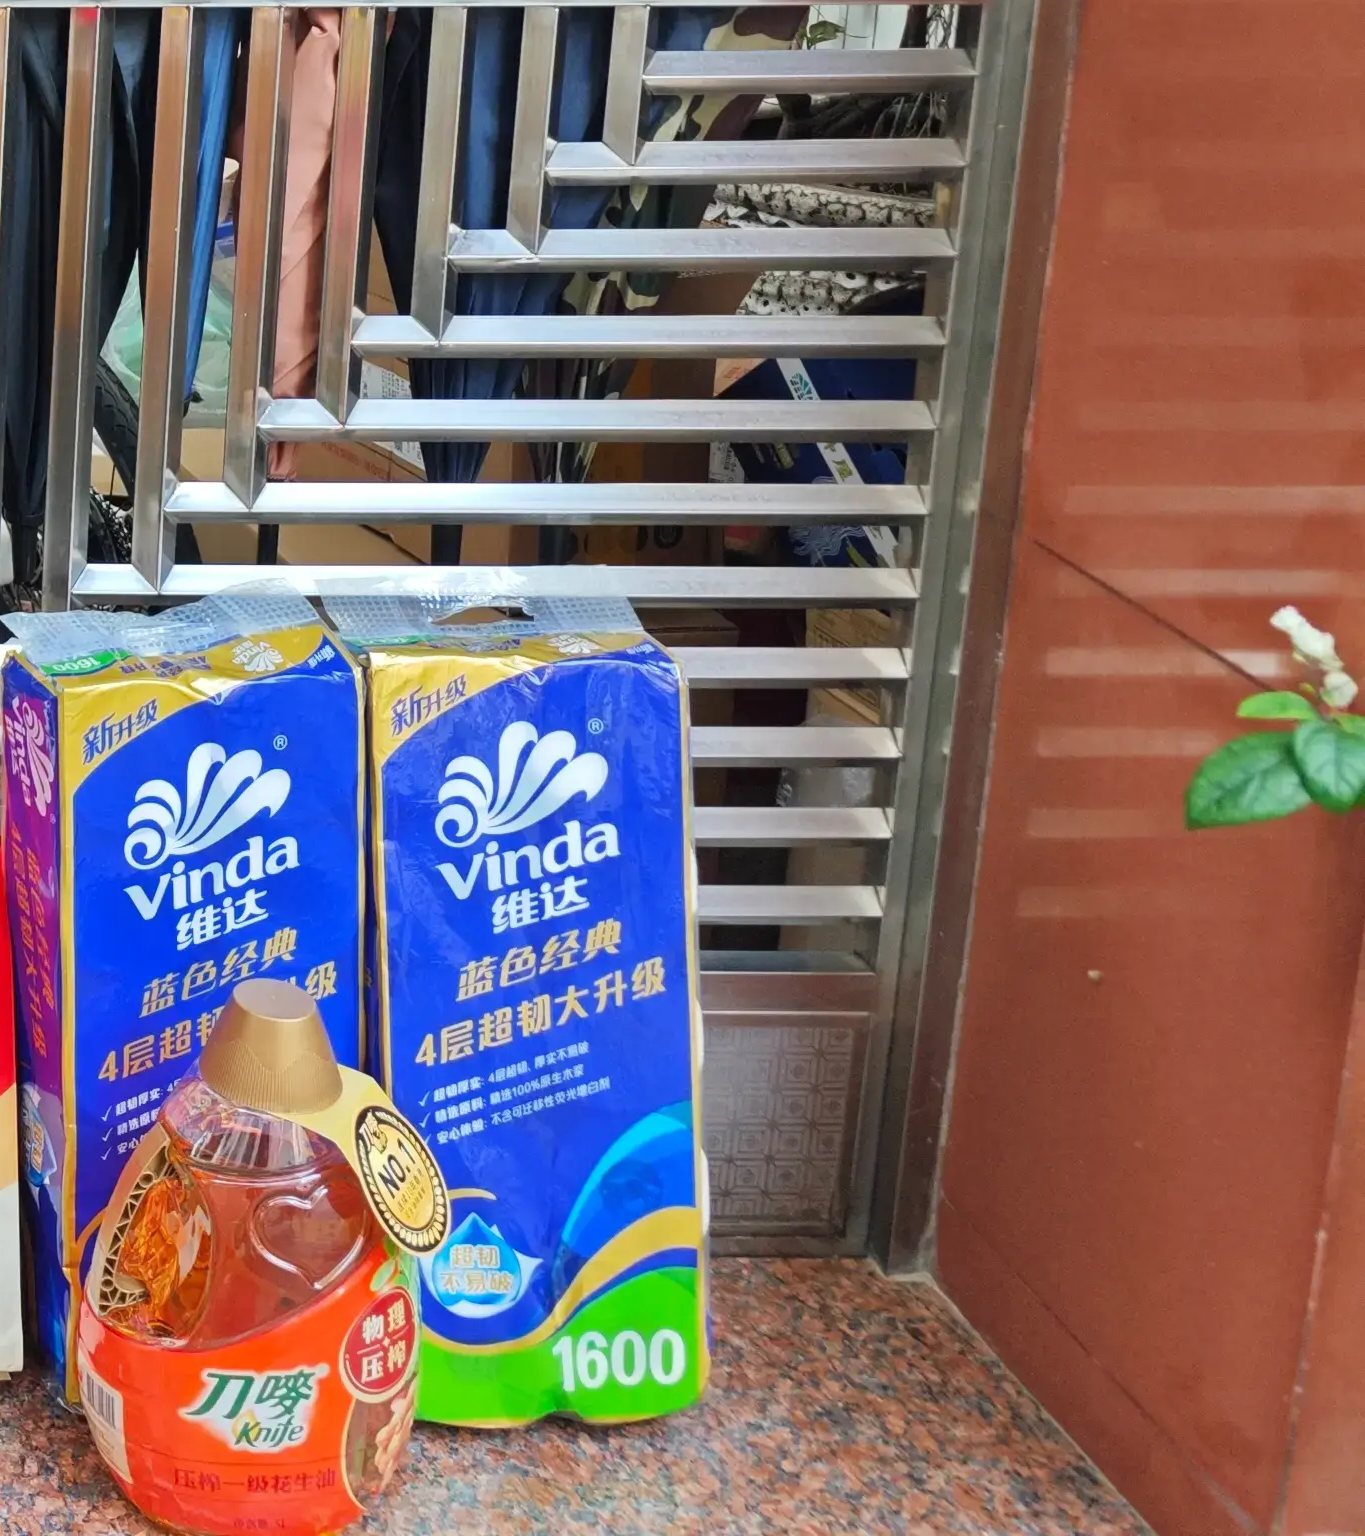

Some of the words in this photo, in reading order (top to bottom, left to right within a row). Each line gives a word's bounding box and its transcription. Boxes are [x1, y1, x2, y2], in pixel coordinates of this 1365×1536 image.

[81, 698, 158, 766] 新升级
[390, 674, 467, 737] 新升级
[123, 835, 301, 921] Vinda
[435, 819, 621, 900] Vinda
[176, 888, 269, 951] 维达
[491, 875, 590, 934] 维达
[138, 926, 298, 1018] 蓝色经典
[455, 917, 622, 1002] 蓝色经典
[414, 956, 666, 1067] 4层超韧大升级
[377, 1137, 416, 1200] NO.1
[440, 1271, 513, 1293] 不易破
[451, 1245, 499, 1267] 超韧
[362, 1298, 406, 1344] 物理
[361, 1340, 406, 1384] 压榨
[552, 1329, 686, 1392] 1600
[234, 1415, 304, 1448] Knife
[174, 1468, 336, 1493] 压榨一级花生油
